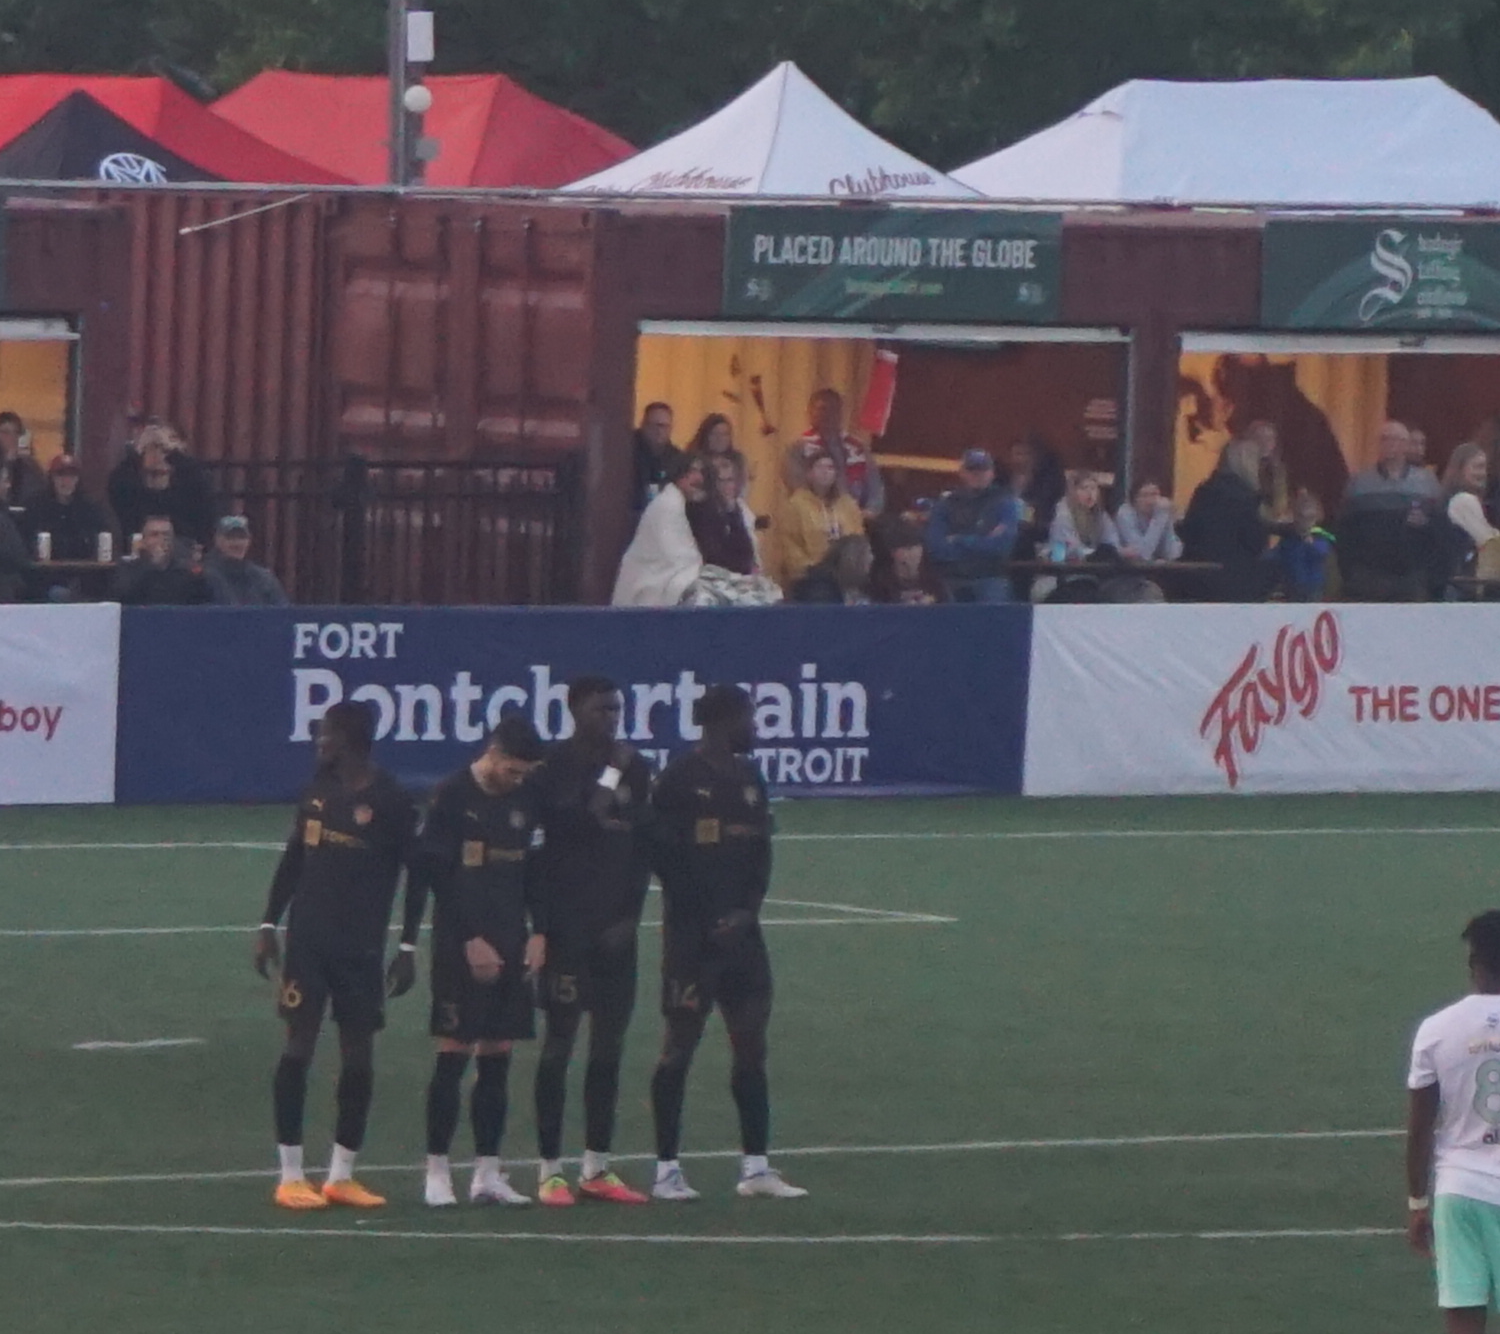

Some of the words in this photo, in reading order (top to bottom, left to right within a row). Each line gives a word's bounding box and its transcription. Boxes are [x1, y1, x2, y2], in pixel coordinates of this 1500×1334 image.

[754, 234, 833, 265] PLACED
[839, 237, 921, 267] AROUND
[928, 238, 966, 267] THE
[972, 239, 1037, 269] GLOBE
[294, 623, 403, 659] FORT
[1200, 610, 1341, 789] Faygo
[1349, 686, 1419, 722] THE
[752, 748, 868, 784] TROIT
